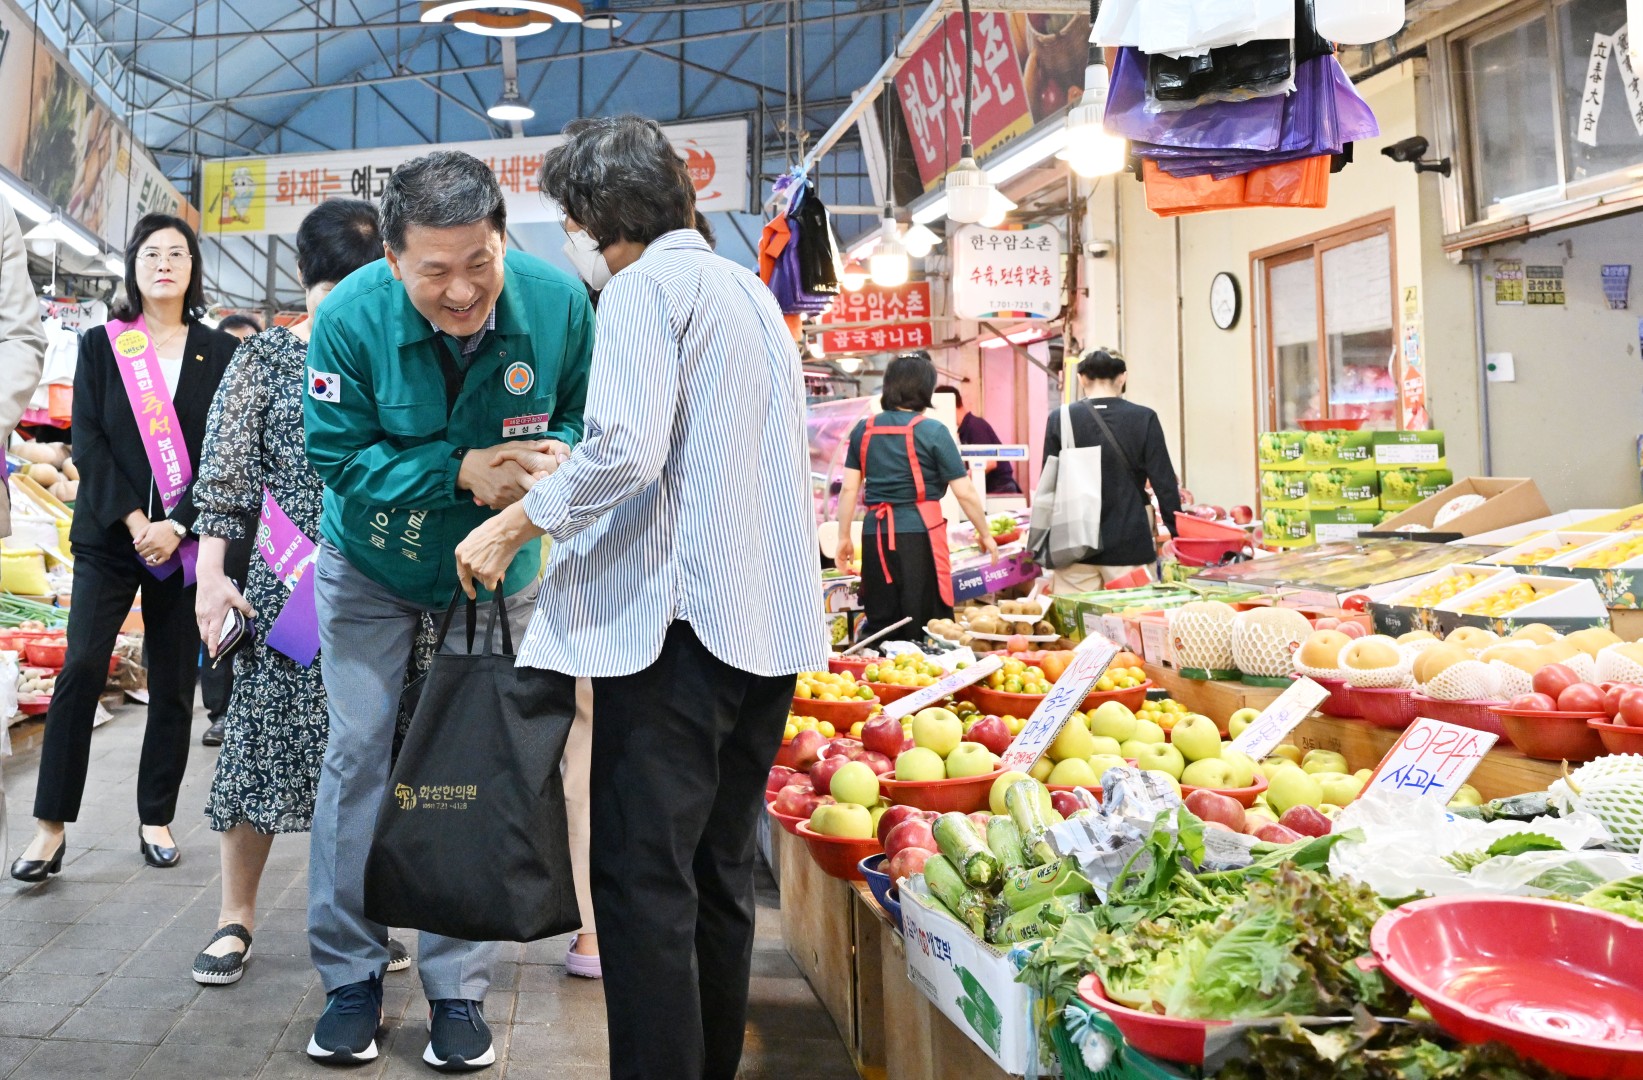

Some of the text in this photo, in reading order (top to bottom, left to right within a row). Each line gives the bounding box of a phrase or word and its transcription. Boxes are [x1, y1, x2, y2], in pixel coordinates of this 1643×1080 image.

[275, 167, 342, 206] 화재는
[970, 234, 1052, 251] 한우암소촌
[831, 290, 925, 325] 한우암소촌
[131, 358, 154, 391] 행복한
[141, 391, 171, 437] 추석
[157, 437, 182, 487] 보내세요
[1020, 716, 1055, 746] 만원
[1403, 725, 1482, 780] 아리수
[418, 784, 477, 800] 화성한의원
[1381, 764, 1444, 795] 사과
[1037, 860, 1060, 878] 애호박
